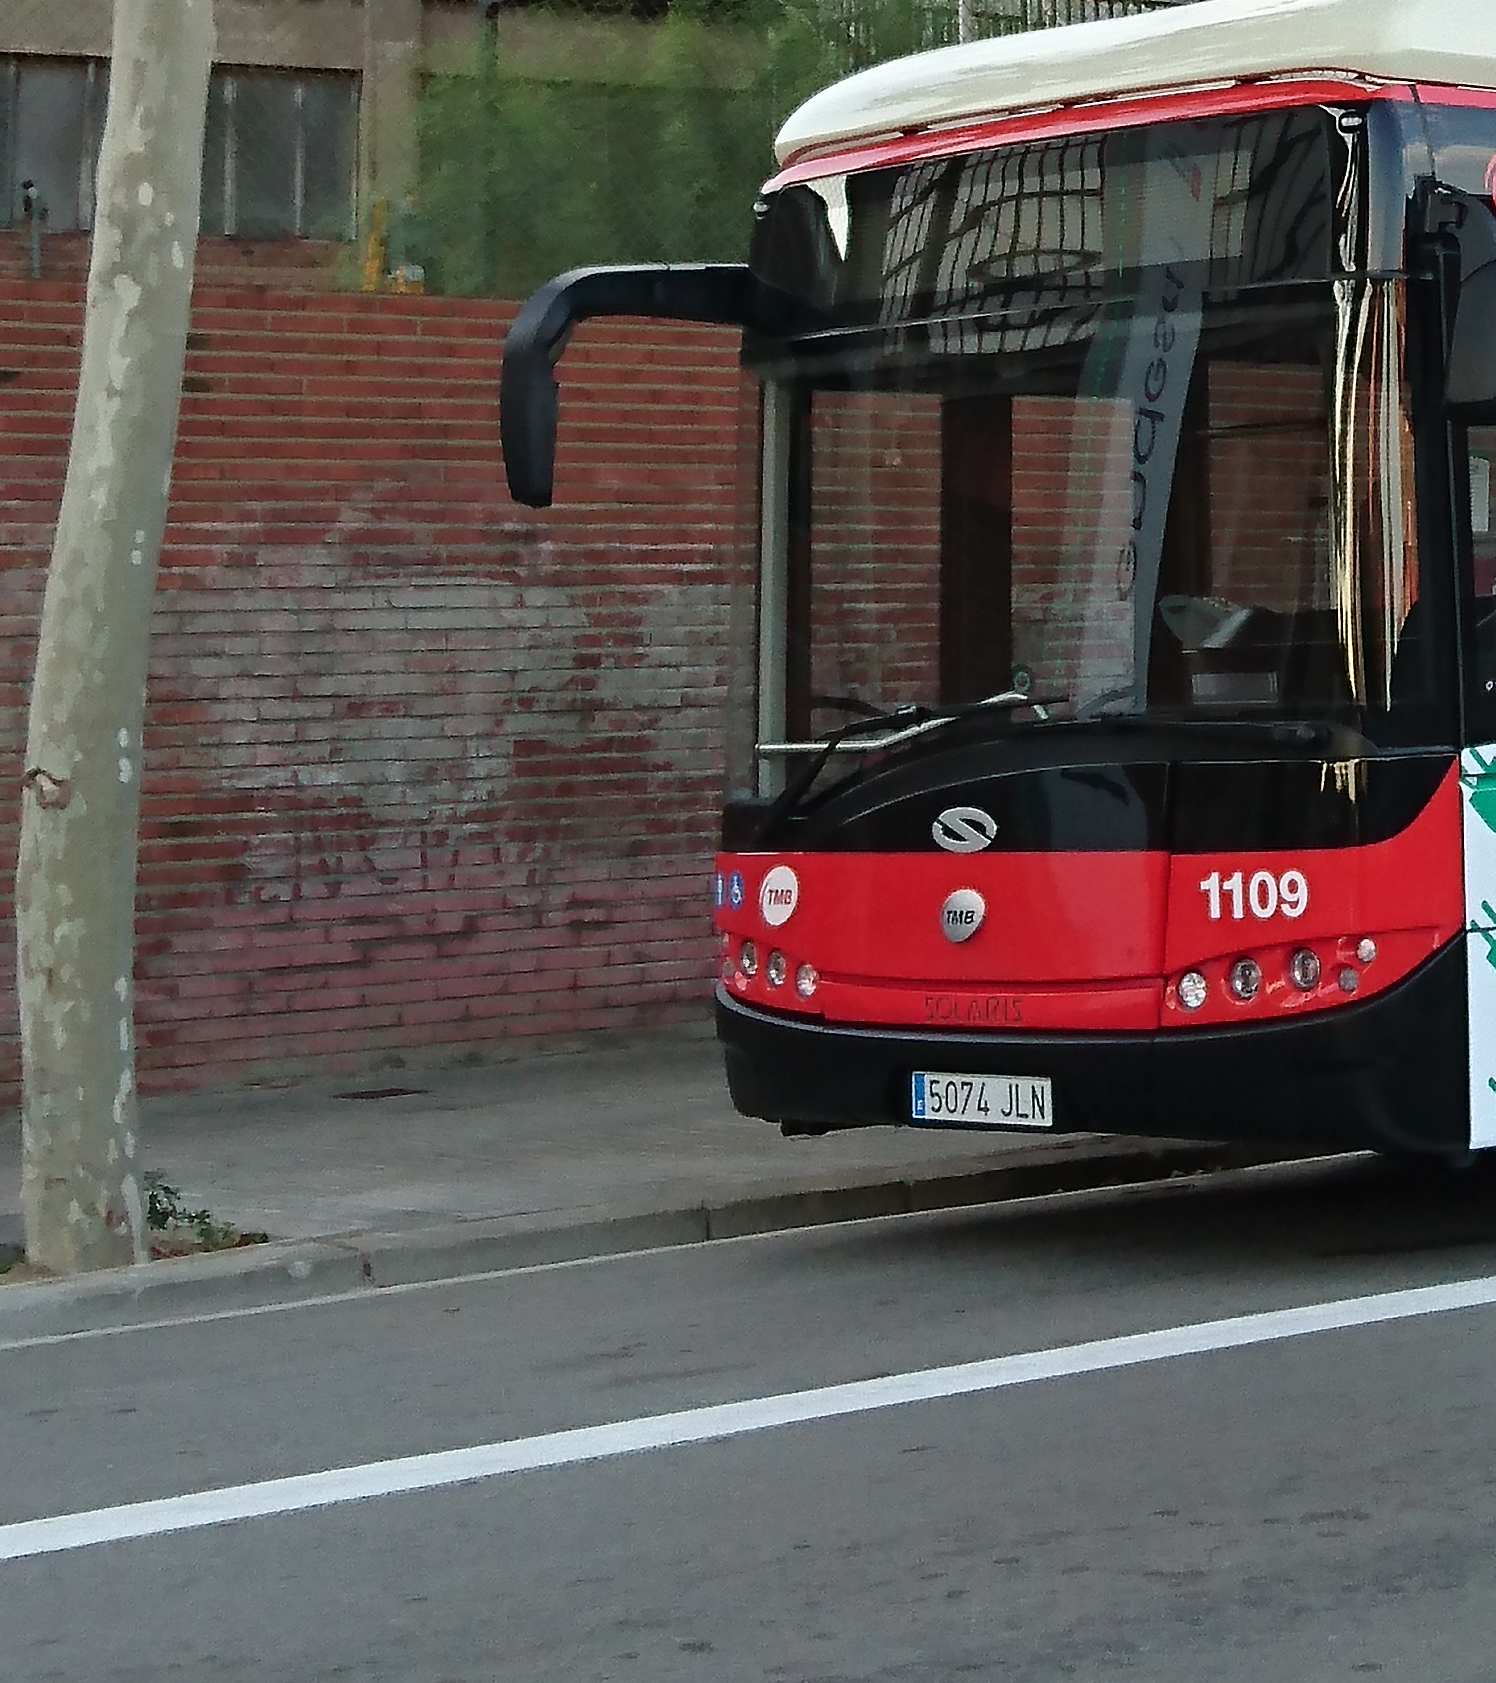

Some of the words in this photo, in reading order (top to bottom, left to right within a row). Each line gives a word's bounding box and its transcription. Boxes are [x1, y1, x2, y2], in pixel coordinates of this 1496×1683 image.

[768, 889, 793, 906] TMB
[1200, 870, 1308, 919] 1109
[947, 910, 975, 925] TMB
[925, 996, 1024, 1023] SOLARIS
[929, 1080, 990, 1116] 5074
[1001, 1083, 1046, 1120] JLN
